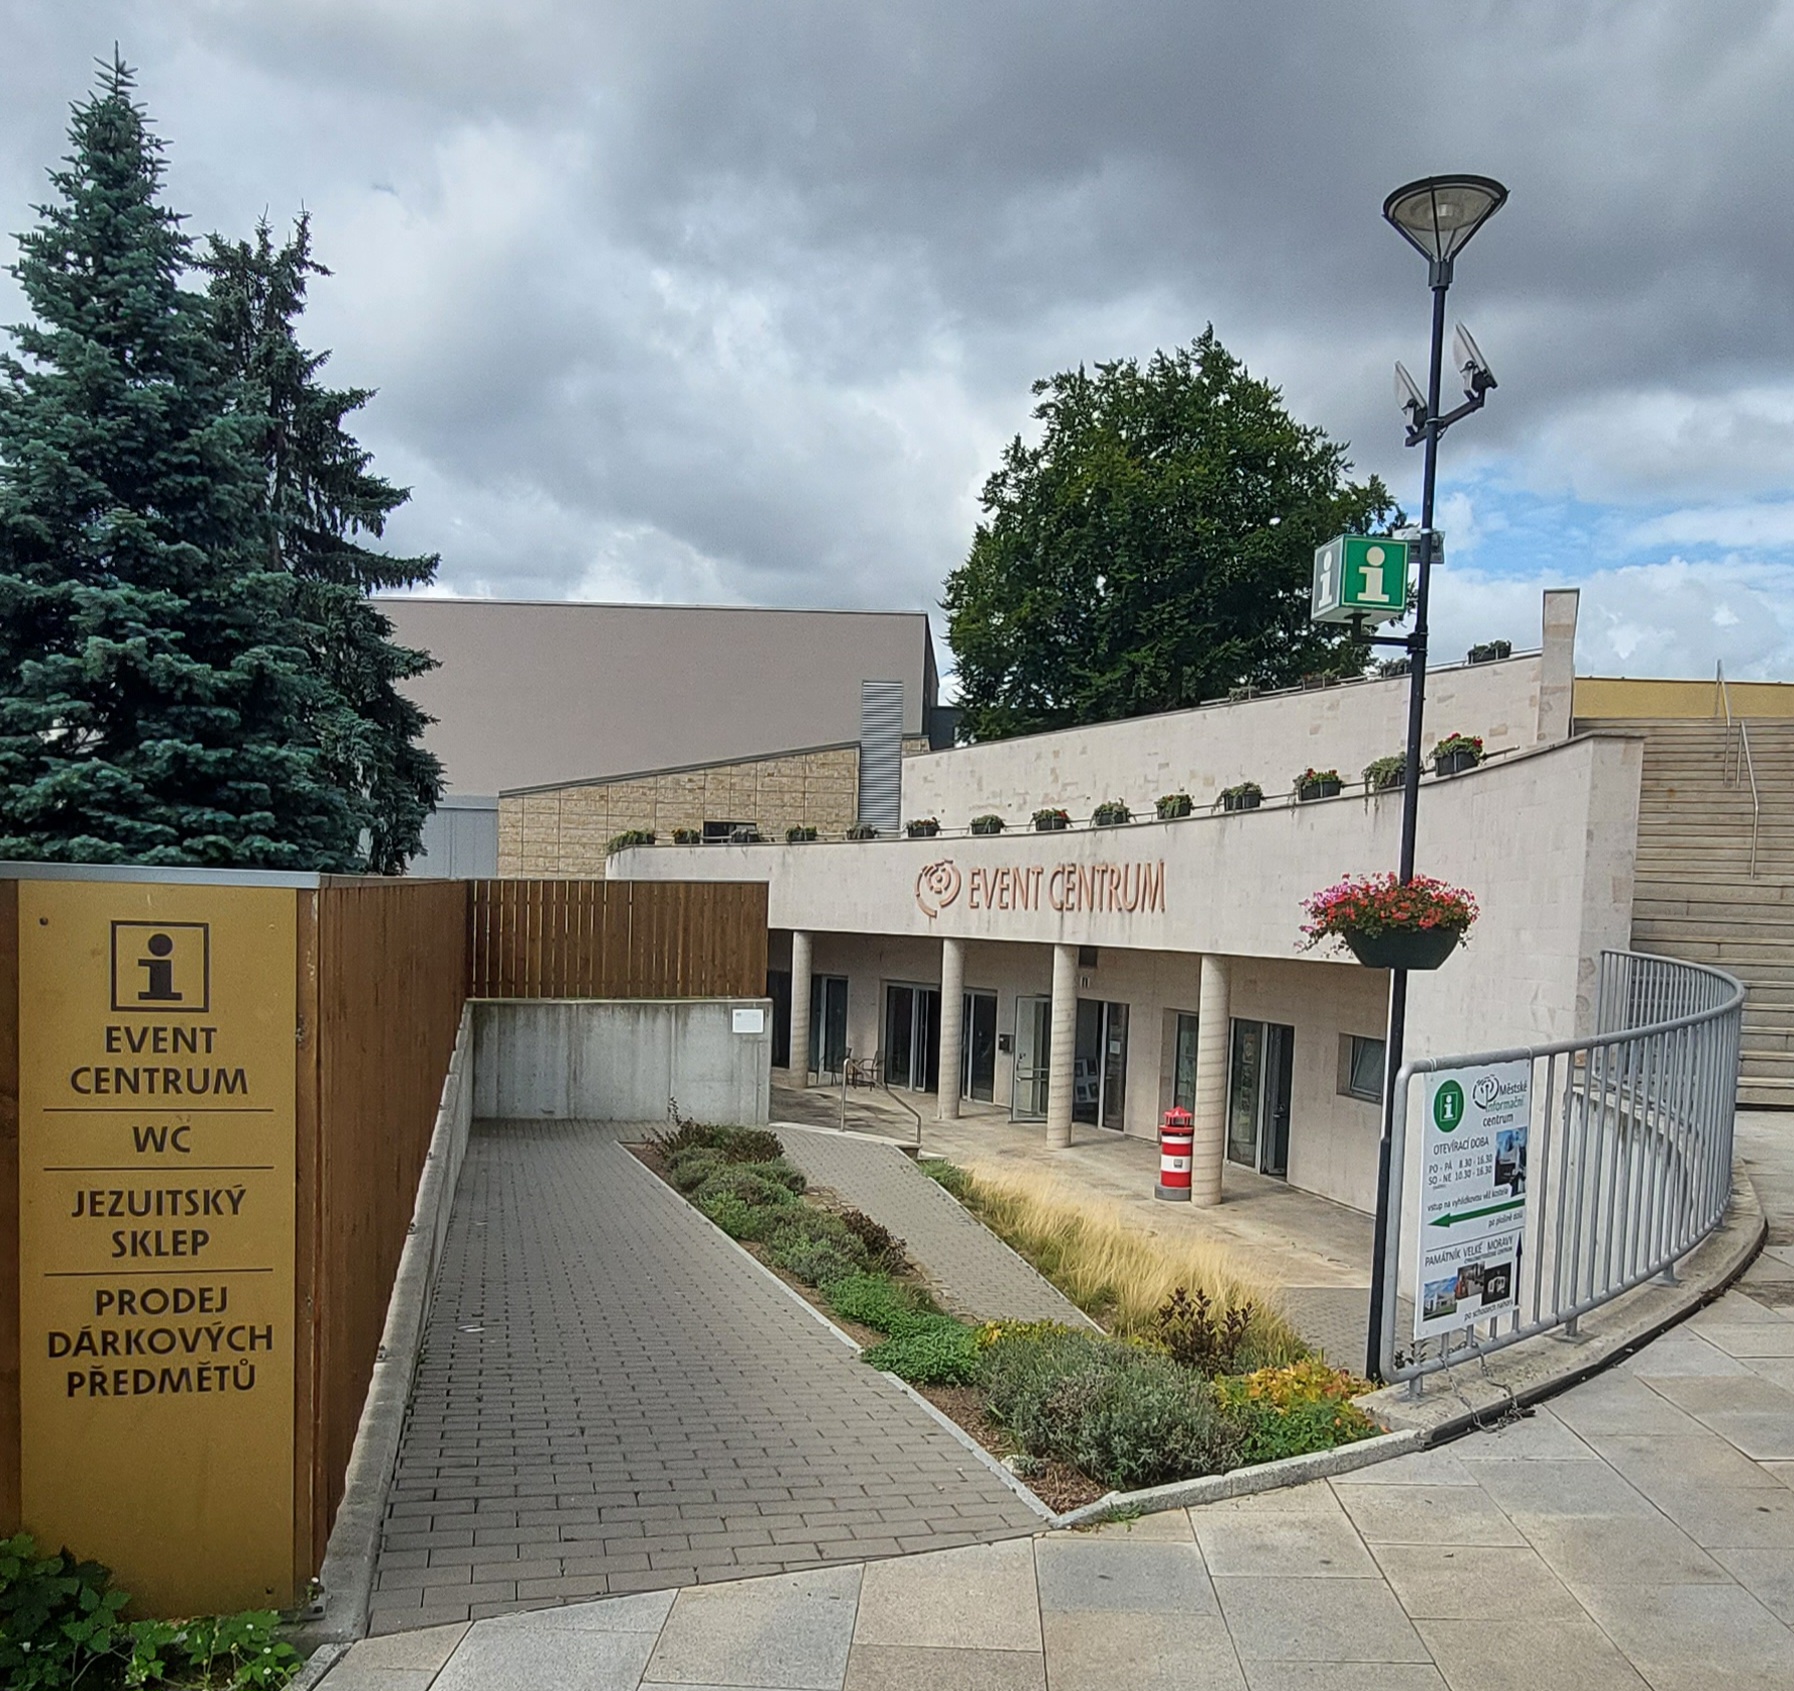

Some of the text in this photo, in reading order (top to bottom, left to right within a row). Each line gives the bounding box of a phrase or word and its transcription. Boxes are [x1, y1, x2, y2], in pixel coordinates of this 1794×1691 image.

[968, 859, 1166, 913] EVENT CENTRUM
[105, 1026, 218, 1054] EVENT
[70, 1066, 248, 1095] CENTRUM
[1483, 1114, 1513, 1127] centrum
[132, 1125, 191, 1153] WC
[1433, 1136, 1489, 1155] OTEVÍRACÍ DOBA
[1428, 1163, 1439, 1174] PO
[1428, 1175, 1438, 1186] SO
[72, 1183, 247, 1218] JEZUITSKÝ
[111, 1230, 209, 1258] SKLEP
[1424, 1247, 1462, 1268] PAMÁTNÍK
[1462, 1241, 1484, 1258] VELKÉ
[96, 1286, 228, 1316] PRODEJ
[48, 1321, 273, 1358] DÁRKOVÝCH
[67, 1358, 256, 1397] PŘEDMĚTŮ
